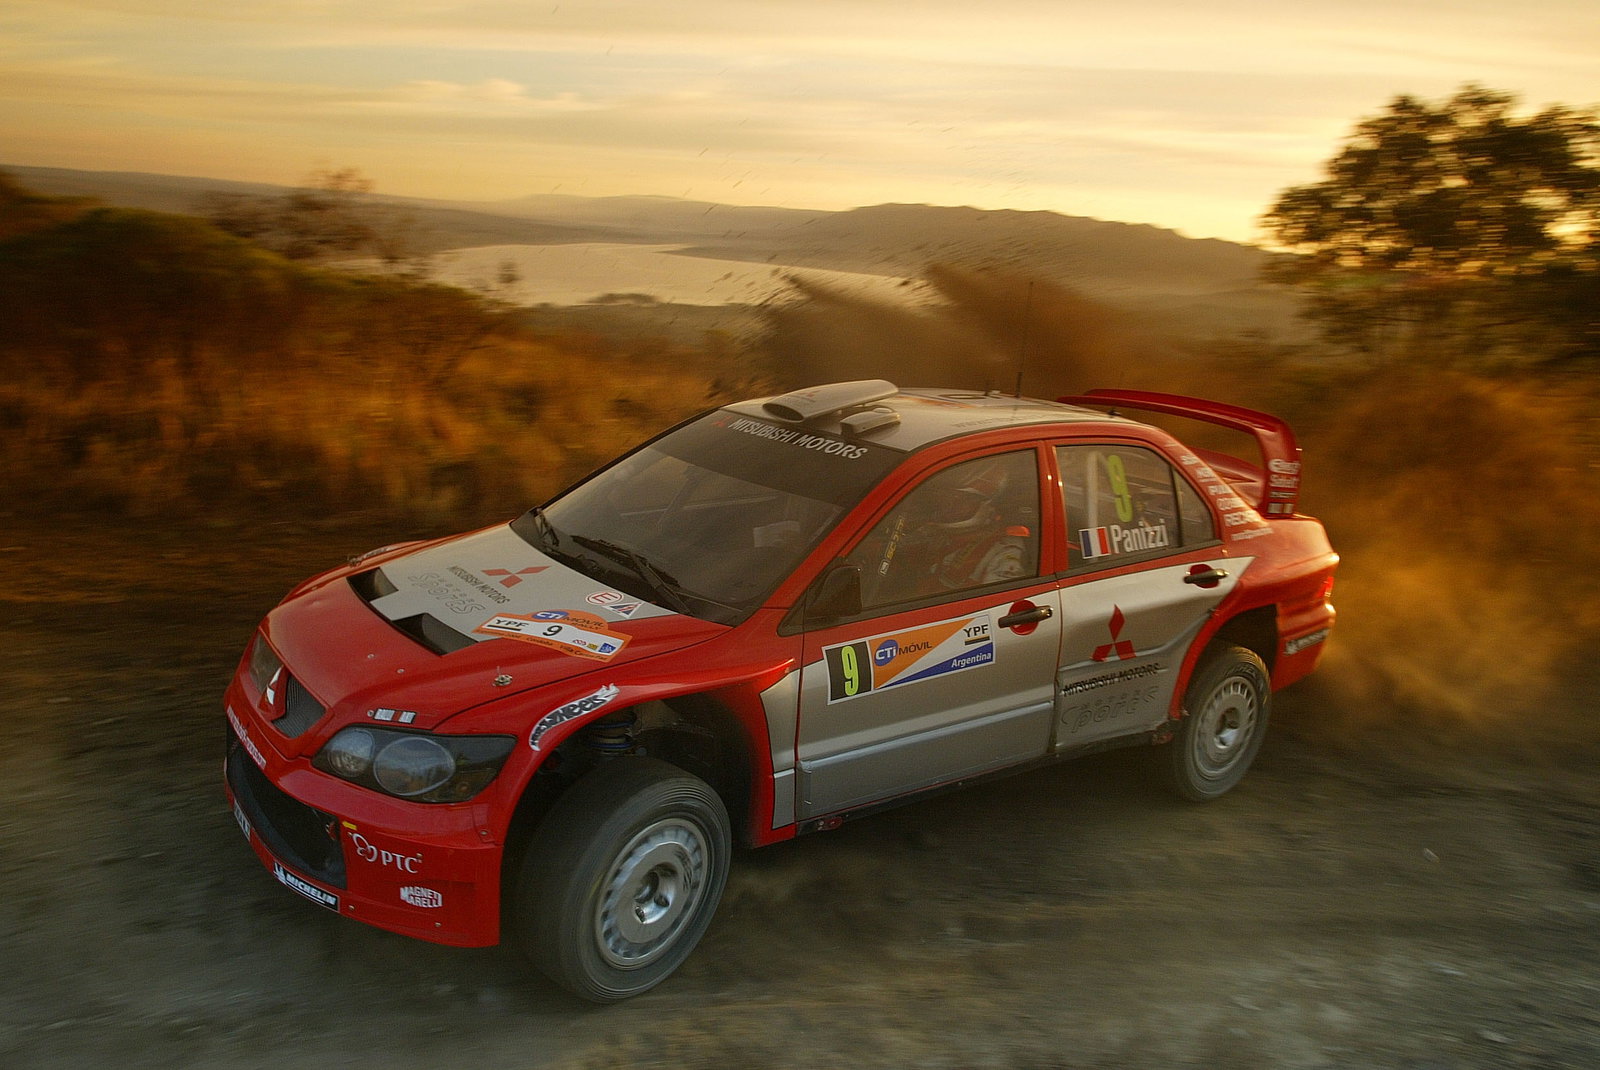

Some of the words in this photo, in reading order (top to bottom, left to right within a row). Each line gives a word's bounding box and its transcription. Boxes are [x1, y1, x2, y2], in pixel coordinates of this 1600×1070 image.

[728, 418, 798, 443] MITSUBISHI
[793, 434, 868, 459] MOTORS
[1107, 454, 1133, 523] 9
[1111, 519, 1169, 553] Panizzi
[495, 618, 529, 628] YPF
[542, 625, 563, 636] 9
[963, 624, 989, 638] YPF
[875, 646, 897, 660] CTi
[898, 640, 933, 656] MÓVIL
[951, 652, 992, 668] Argentina
[841, 645, 860, 696] 9
[380, 849, 418, 873] PTC
[286, 872, 337, 906] MICHELIN
